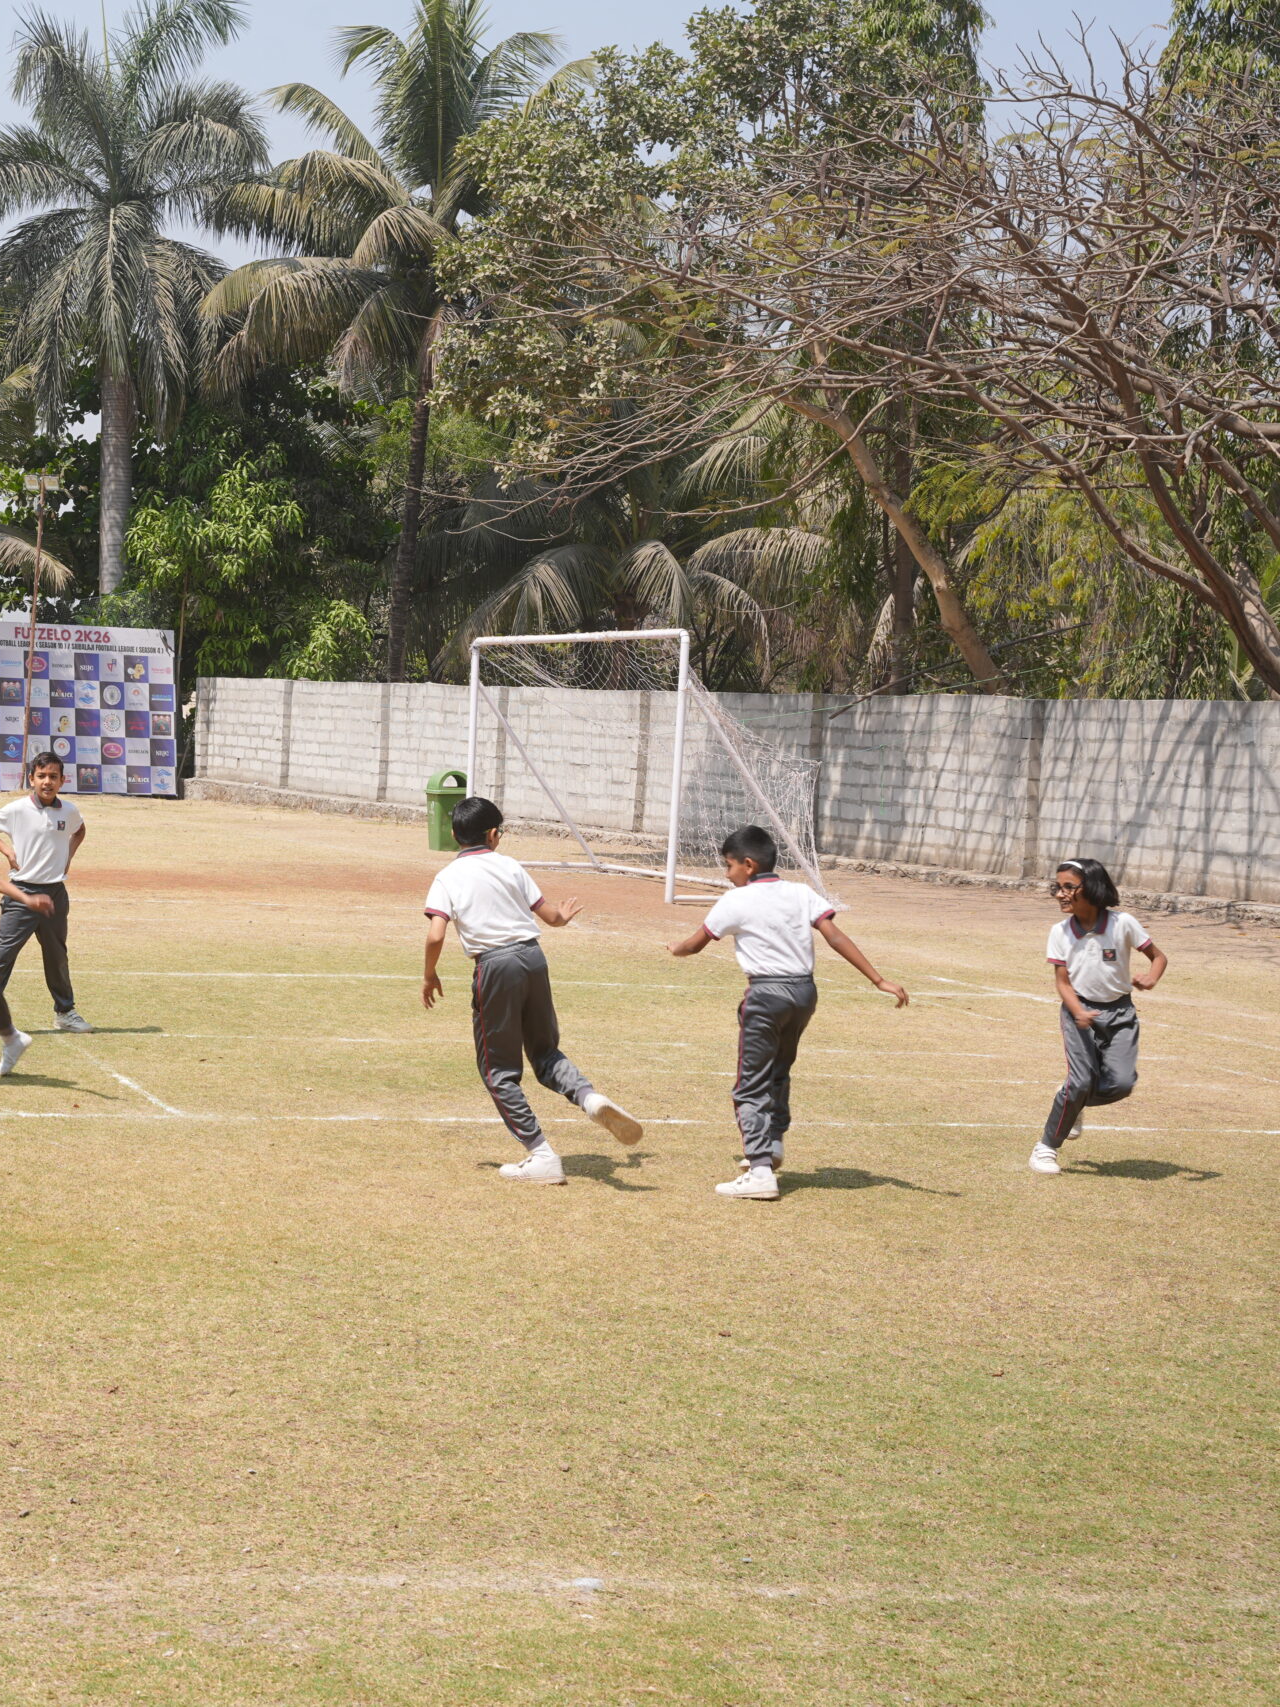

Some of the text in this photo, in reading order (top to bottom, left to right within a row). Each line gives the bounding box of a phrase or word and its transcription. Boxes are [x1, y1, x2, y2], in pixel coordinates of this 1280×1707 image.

[75, 629, 111, 644] 2K26
[39, 641, 57, 649] SEASON
[95, 644, 117, 652] FOOTBALL
[118, 645, 135, 653] LEAGUE
